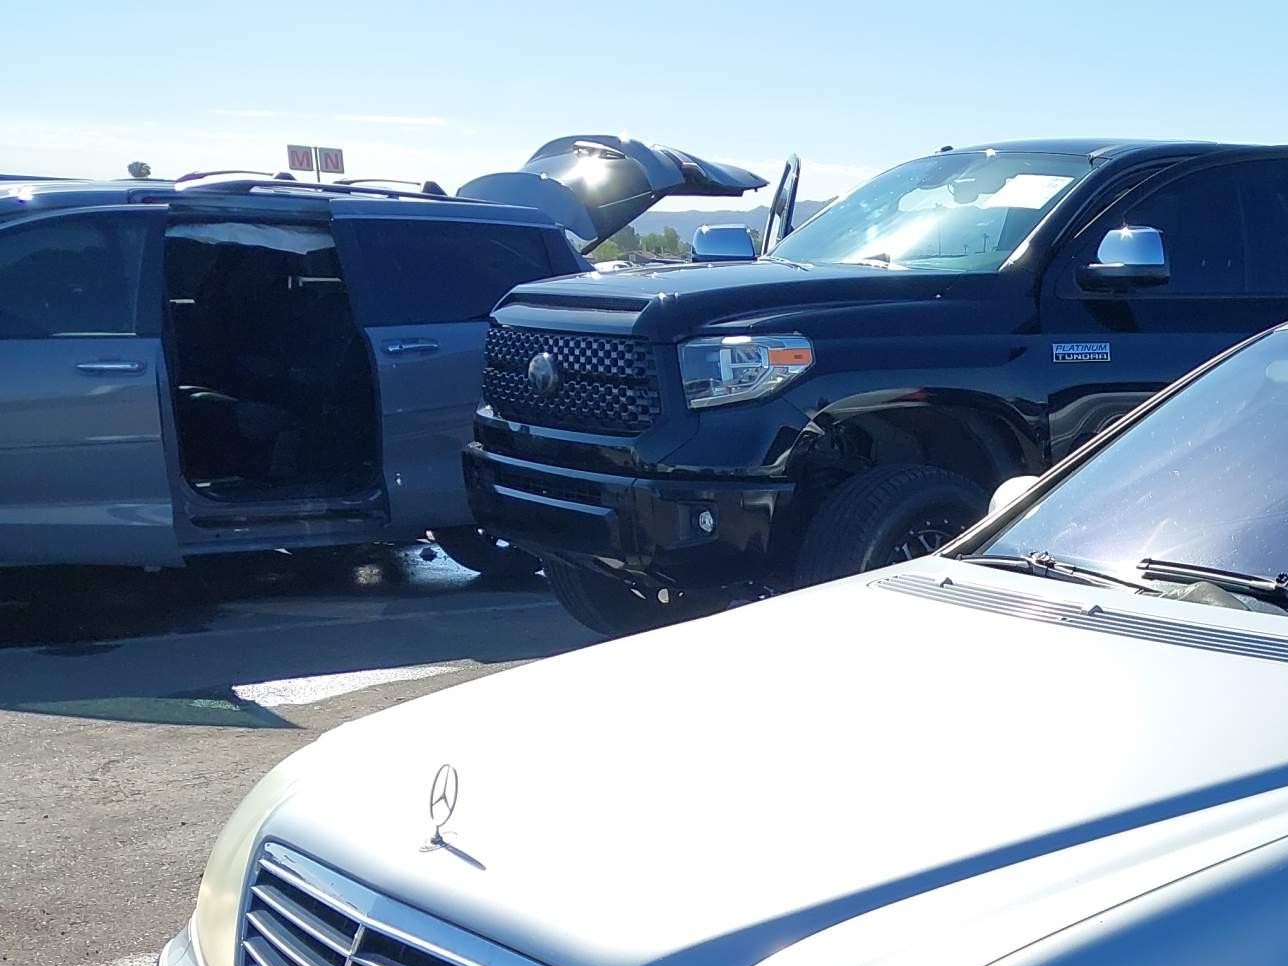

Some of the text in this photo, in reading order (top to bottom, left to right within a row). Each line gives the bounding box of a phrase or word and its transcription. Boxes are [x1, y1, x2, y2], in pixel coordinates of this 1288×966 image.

[290, 150, 311, 168] M
[324, 152, 340, 169] N
[1055, 344, 1107, 352] PLATINUM
